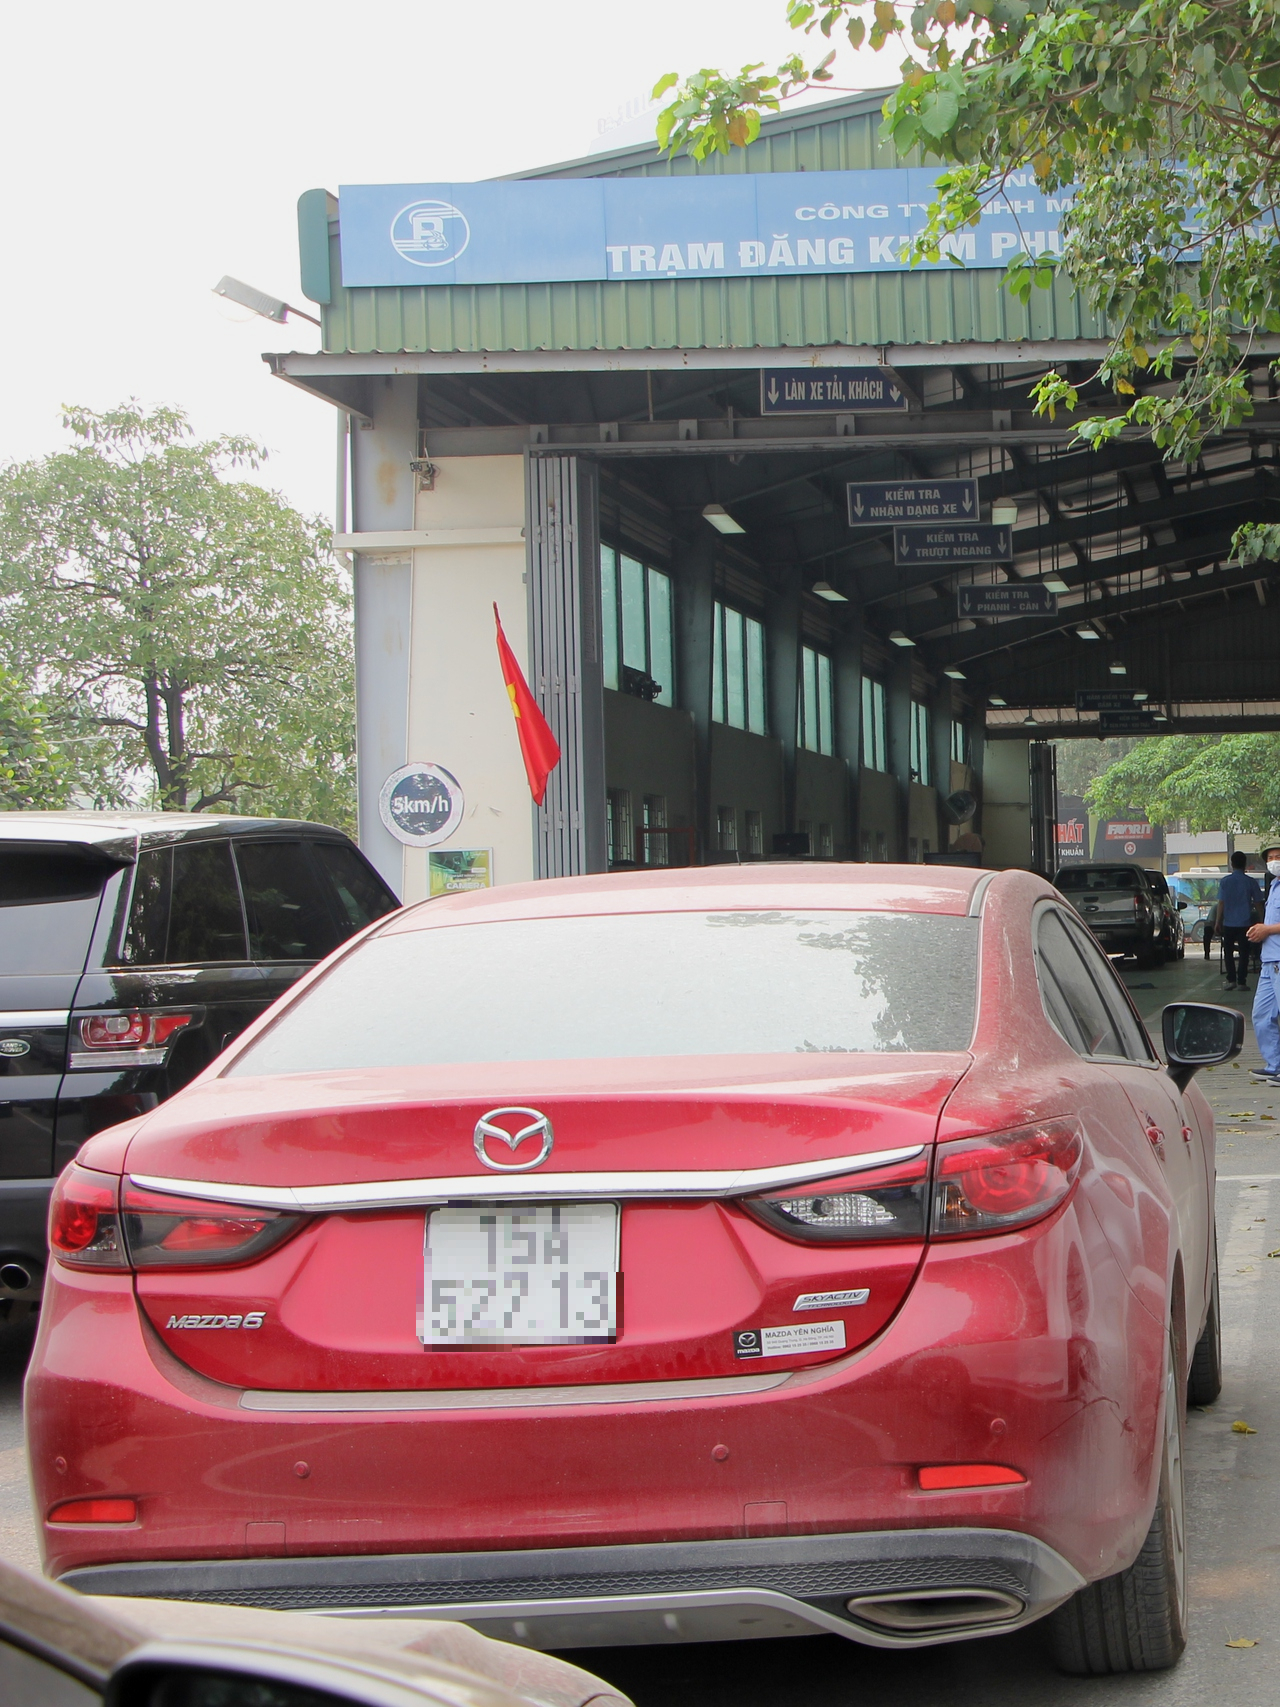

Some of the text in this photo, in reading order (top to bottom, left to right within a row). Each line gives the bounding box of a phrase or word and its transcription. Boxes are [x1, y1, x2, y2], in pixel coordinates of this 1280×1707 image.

[795, 203, 889, 221] CÔNG
[606, 242, 725, 277] TRẠM
[738, 233, 854, 268] ĐĂNG
[785, 374, 883, 402] LÀN XE TẢI, KHÁCH
[885, 486, 941, 501] KIỂM TRA
[870, 503, 958, 519] NHẬN DẠNG XE
[926, 530, 979, 543] KIỂM TRA
[953, 545, 992, 557] NGANG
[1012, 591, 1030, 599] TRA
[392, 795, 449, 815] 5km/h
[802, 1291, 862, 1303] SKYACTIV
[765, 1331, 792, 1339] MAZDA
[792, 1328, 808, 1336] YÊN
[810, 1325, 835, 1334] NGHĨA
